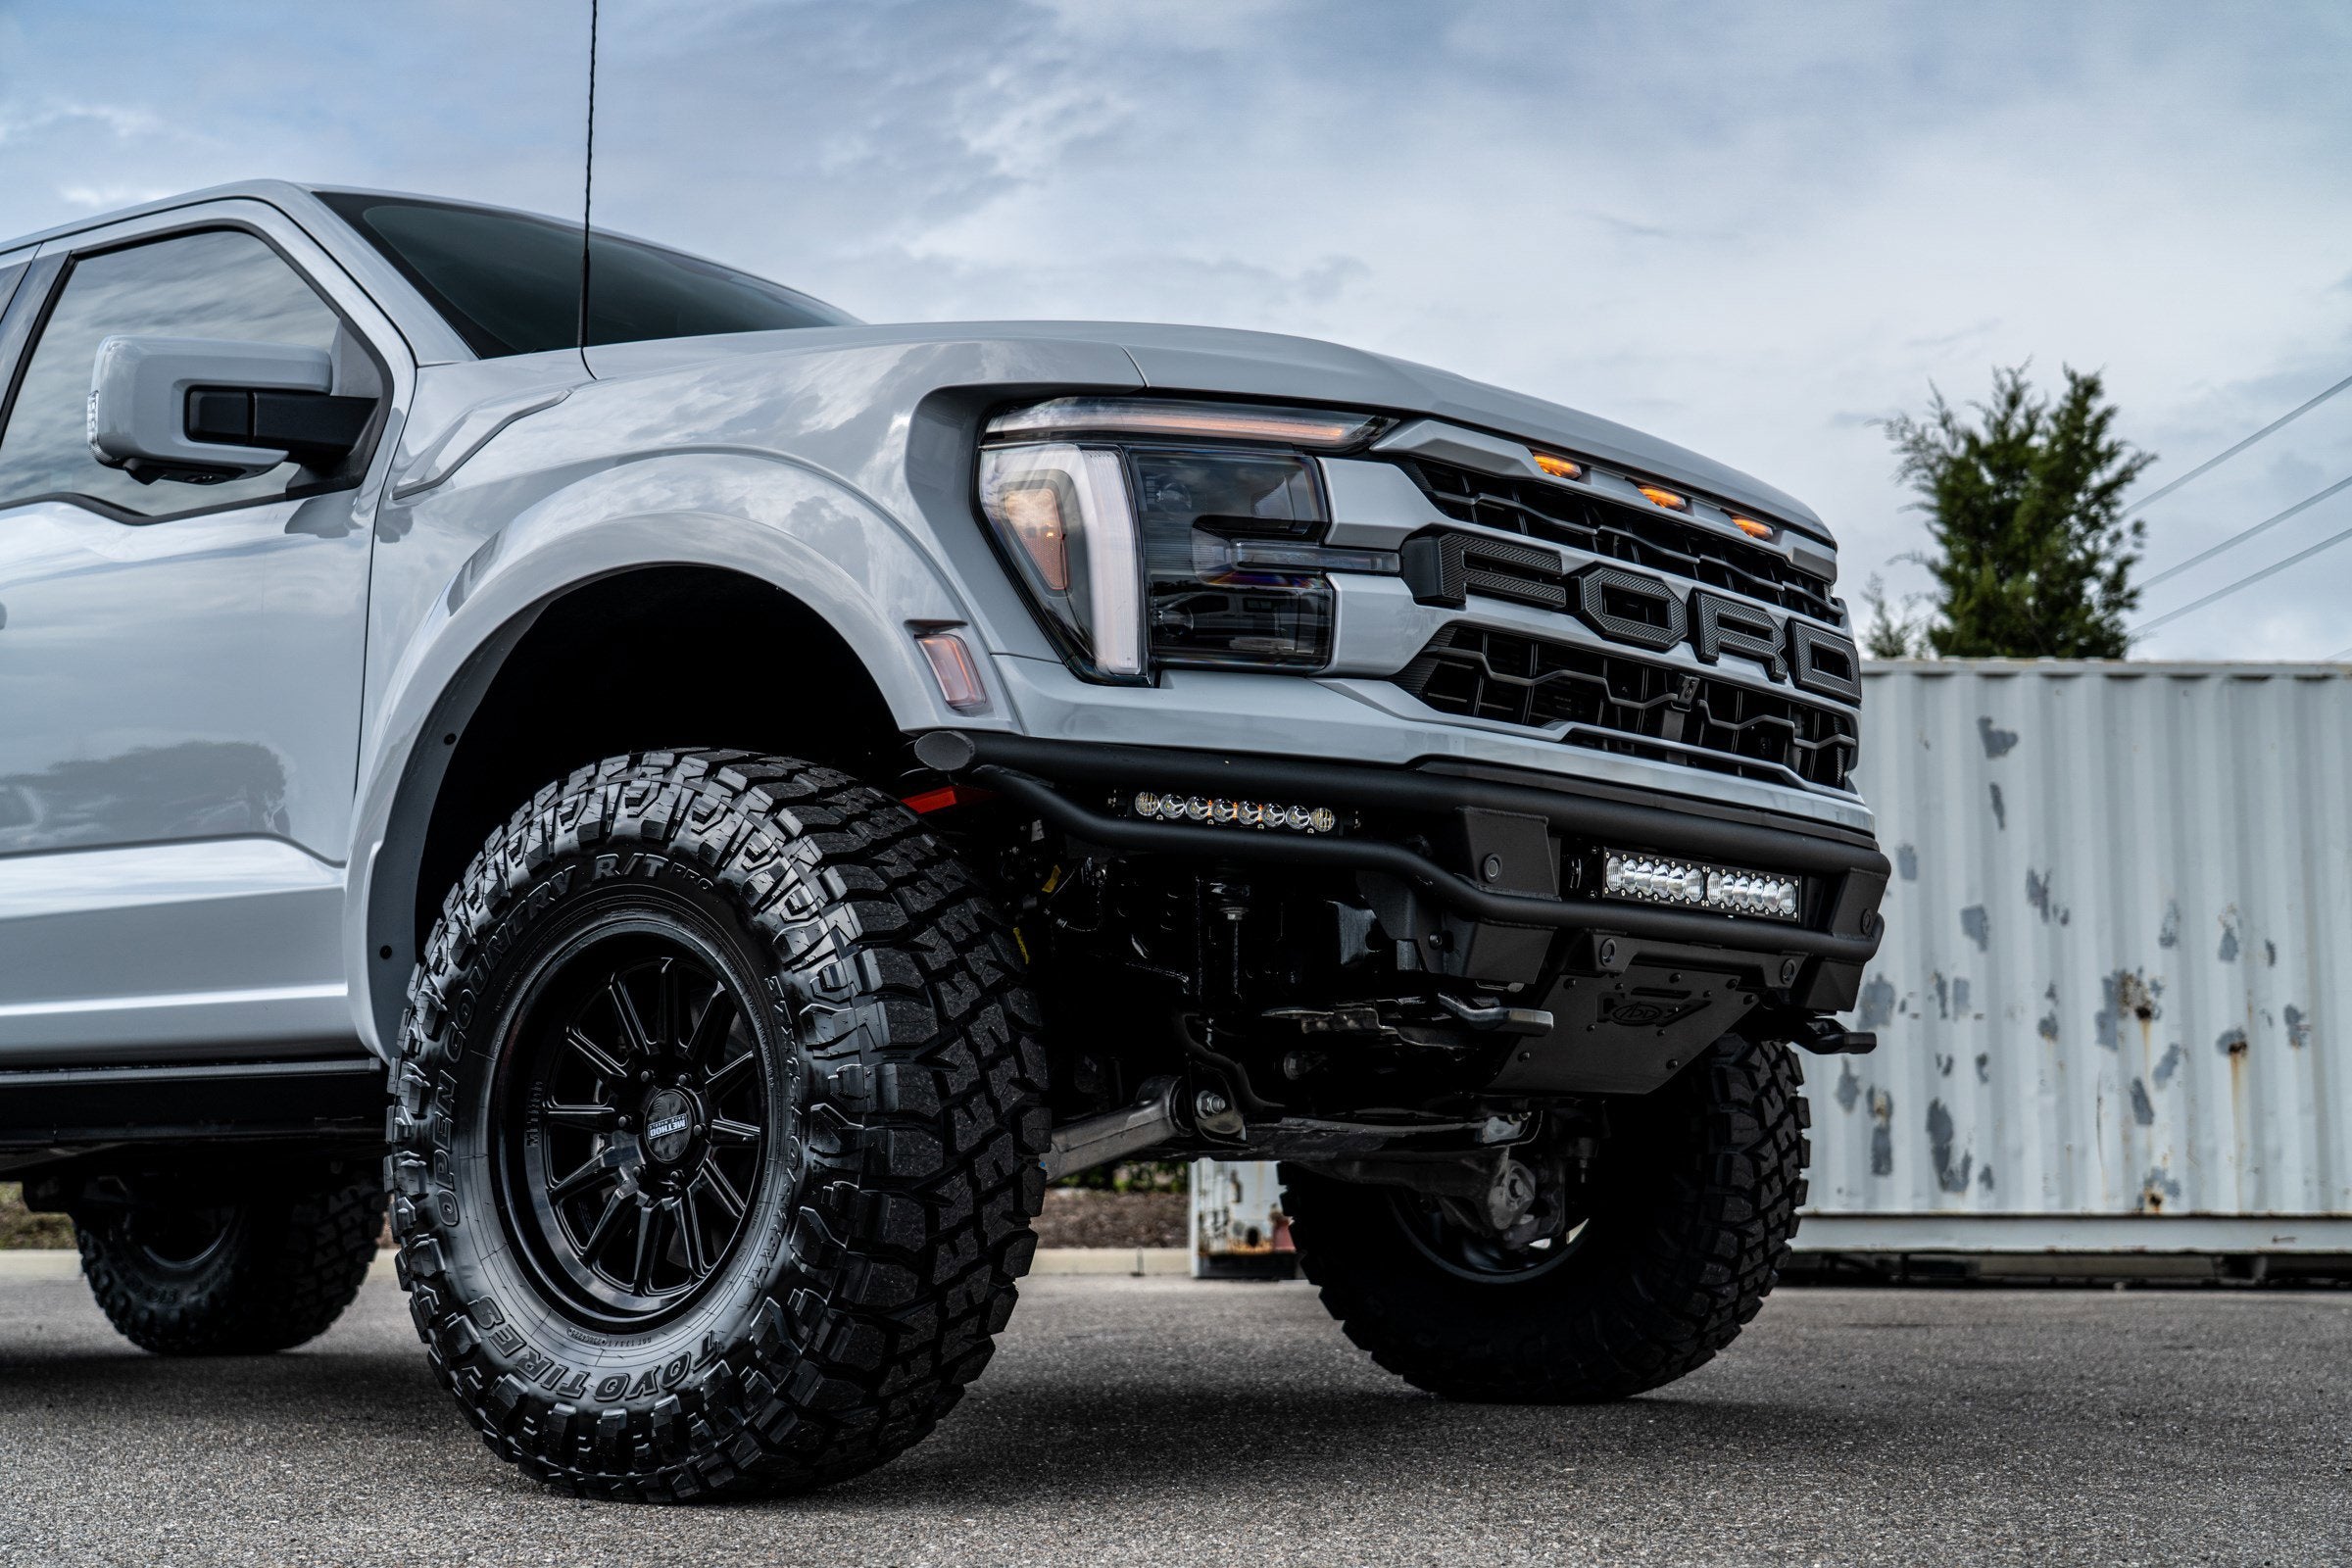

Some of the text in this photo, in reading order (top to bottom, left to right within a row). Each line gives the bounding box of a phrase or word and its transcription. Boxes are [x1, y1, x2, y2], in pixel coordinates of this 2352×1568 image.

[1403, 531, 1862, 707] FORD
[593, 851, 670, 881] R/T
[445, 864, 578, 1064] COUNTRY
[434, 1075, 460, 1227] OPEN
[649, 1119, 686, 1138] METHOD
[466, 1294, 726, 1402] TOYO TIRES
